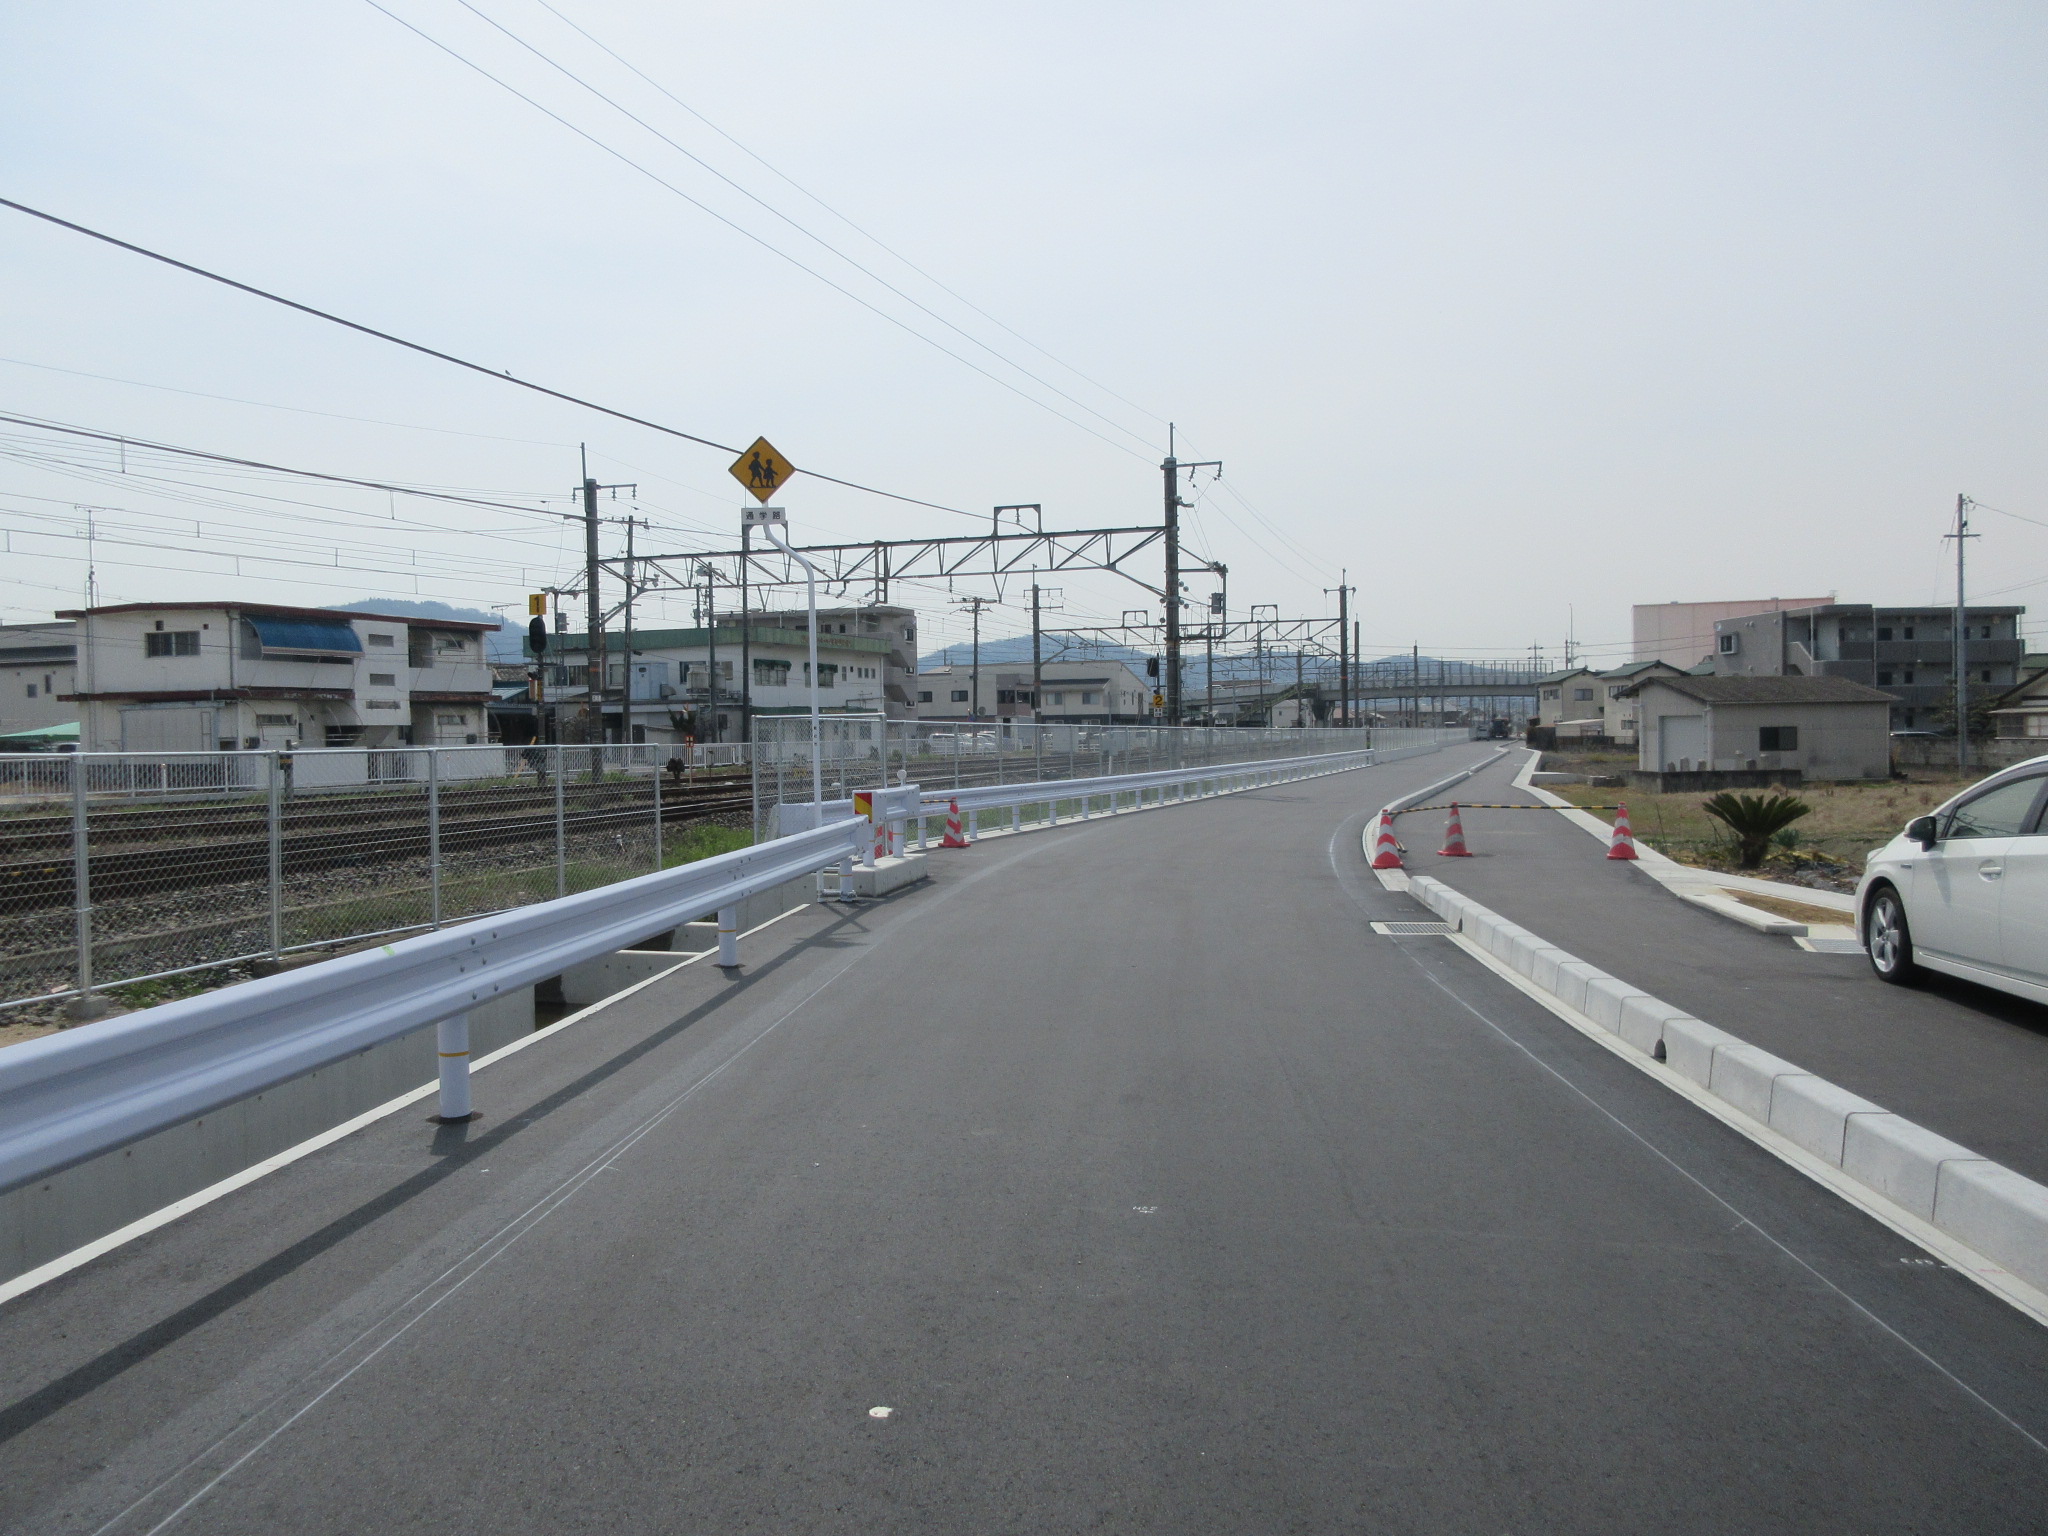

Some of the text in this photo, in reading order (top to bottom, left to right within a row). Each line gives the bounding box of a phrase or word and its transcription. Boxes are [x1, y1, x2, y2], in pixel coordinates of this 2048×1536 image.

[745, 511, 781, 521] 通学路
[1155, 695, 1163, 706] 2
